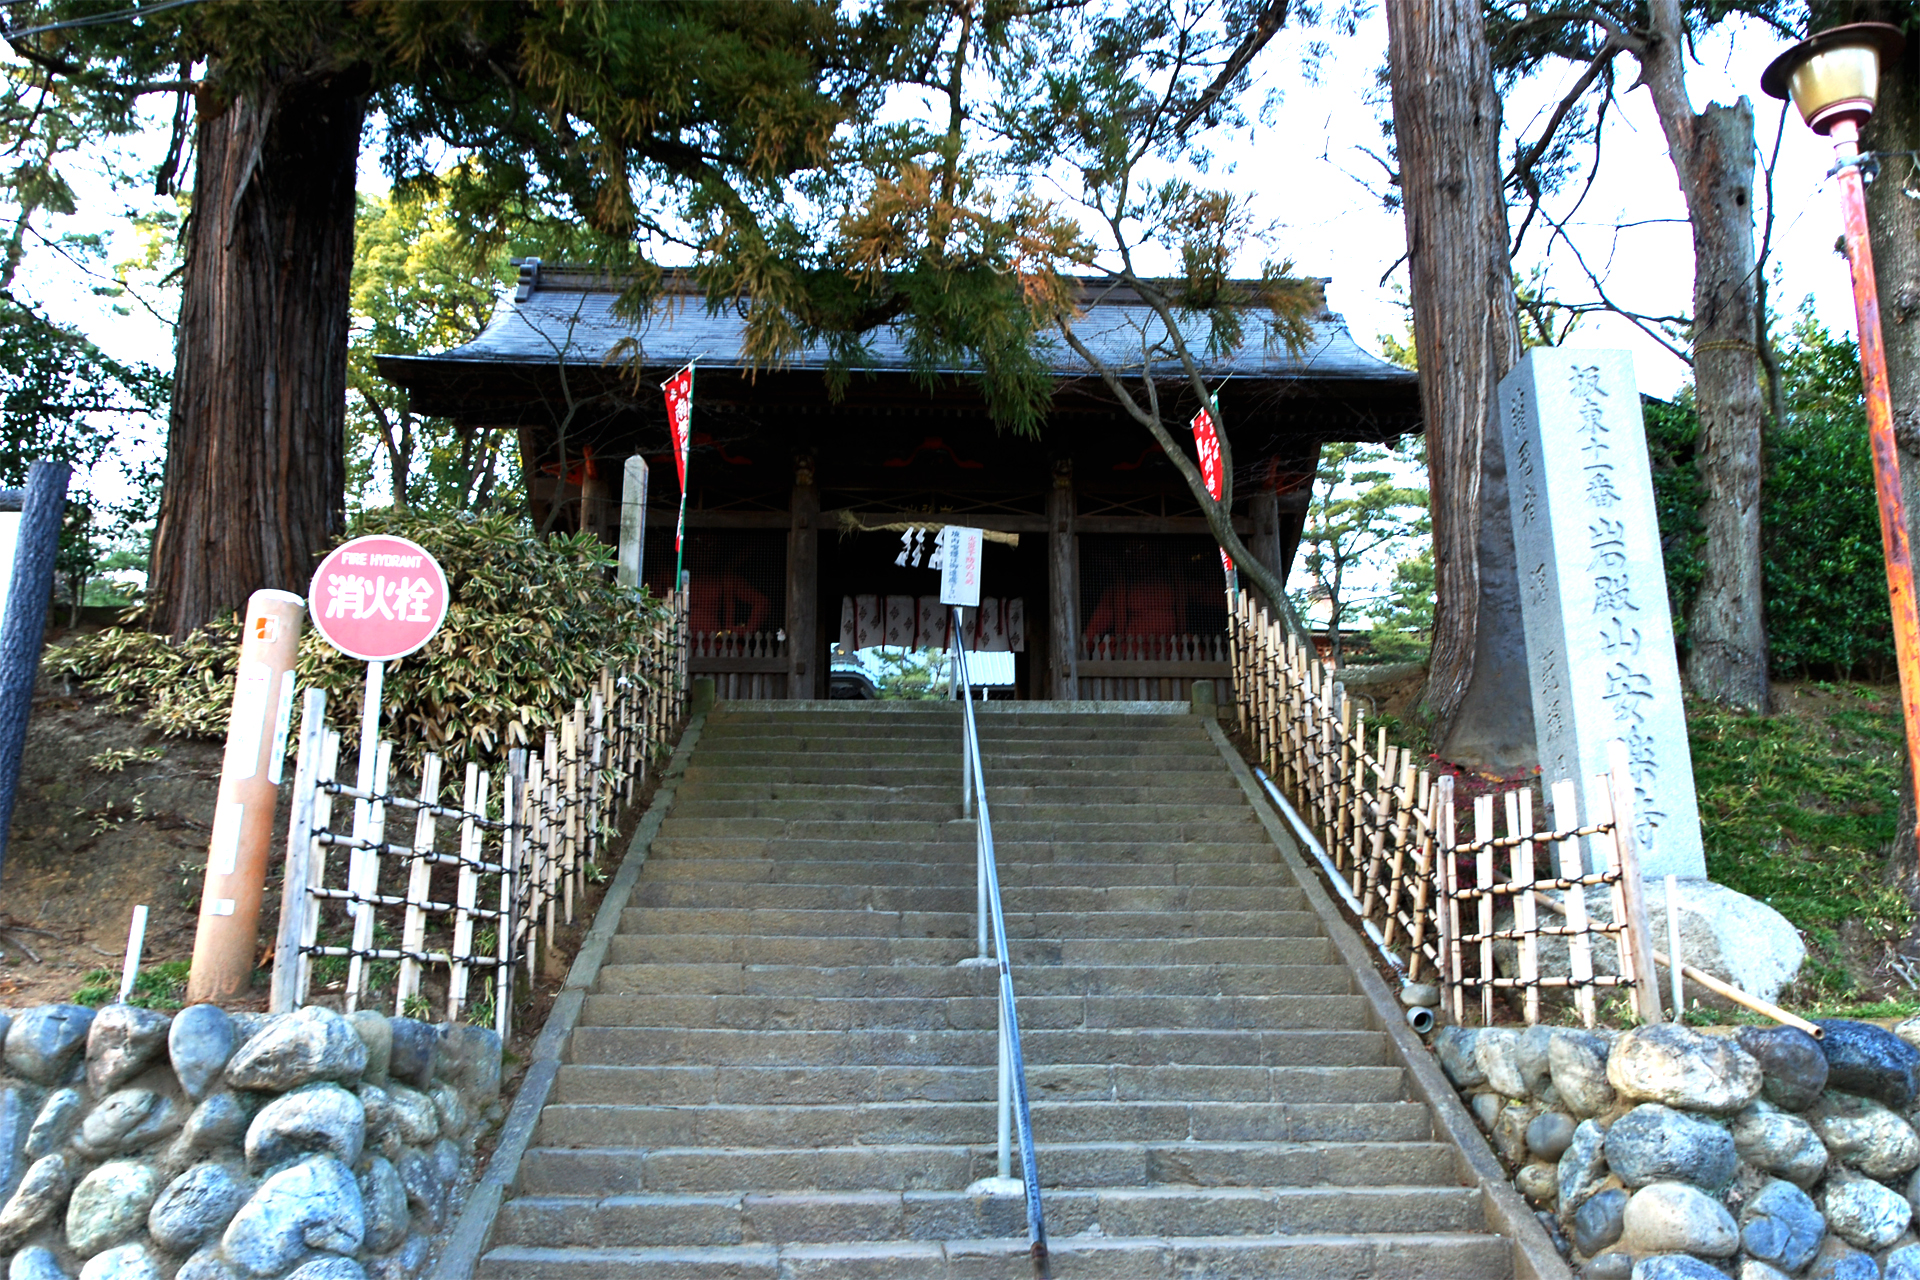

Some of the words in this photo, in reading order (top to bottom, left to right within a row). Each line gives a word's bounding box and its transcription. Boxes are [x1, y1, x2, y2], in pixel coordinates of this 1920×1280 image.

[341, 551, 367, 566] FIRE
[369, 553, 423, 568] HYDRANT
[325, 573, 434, 622] 消火栓
